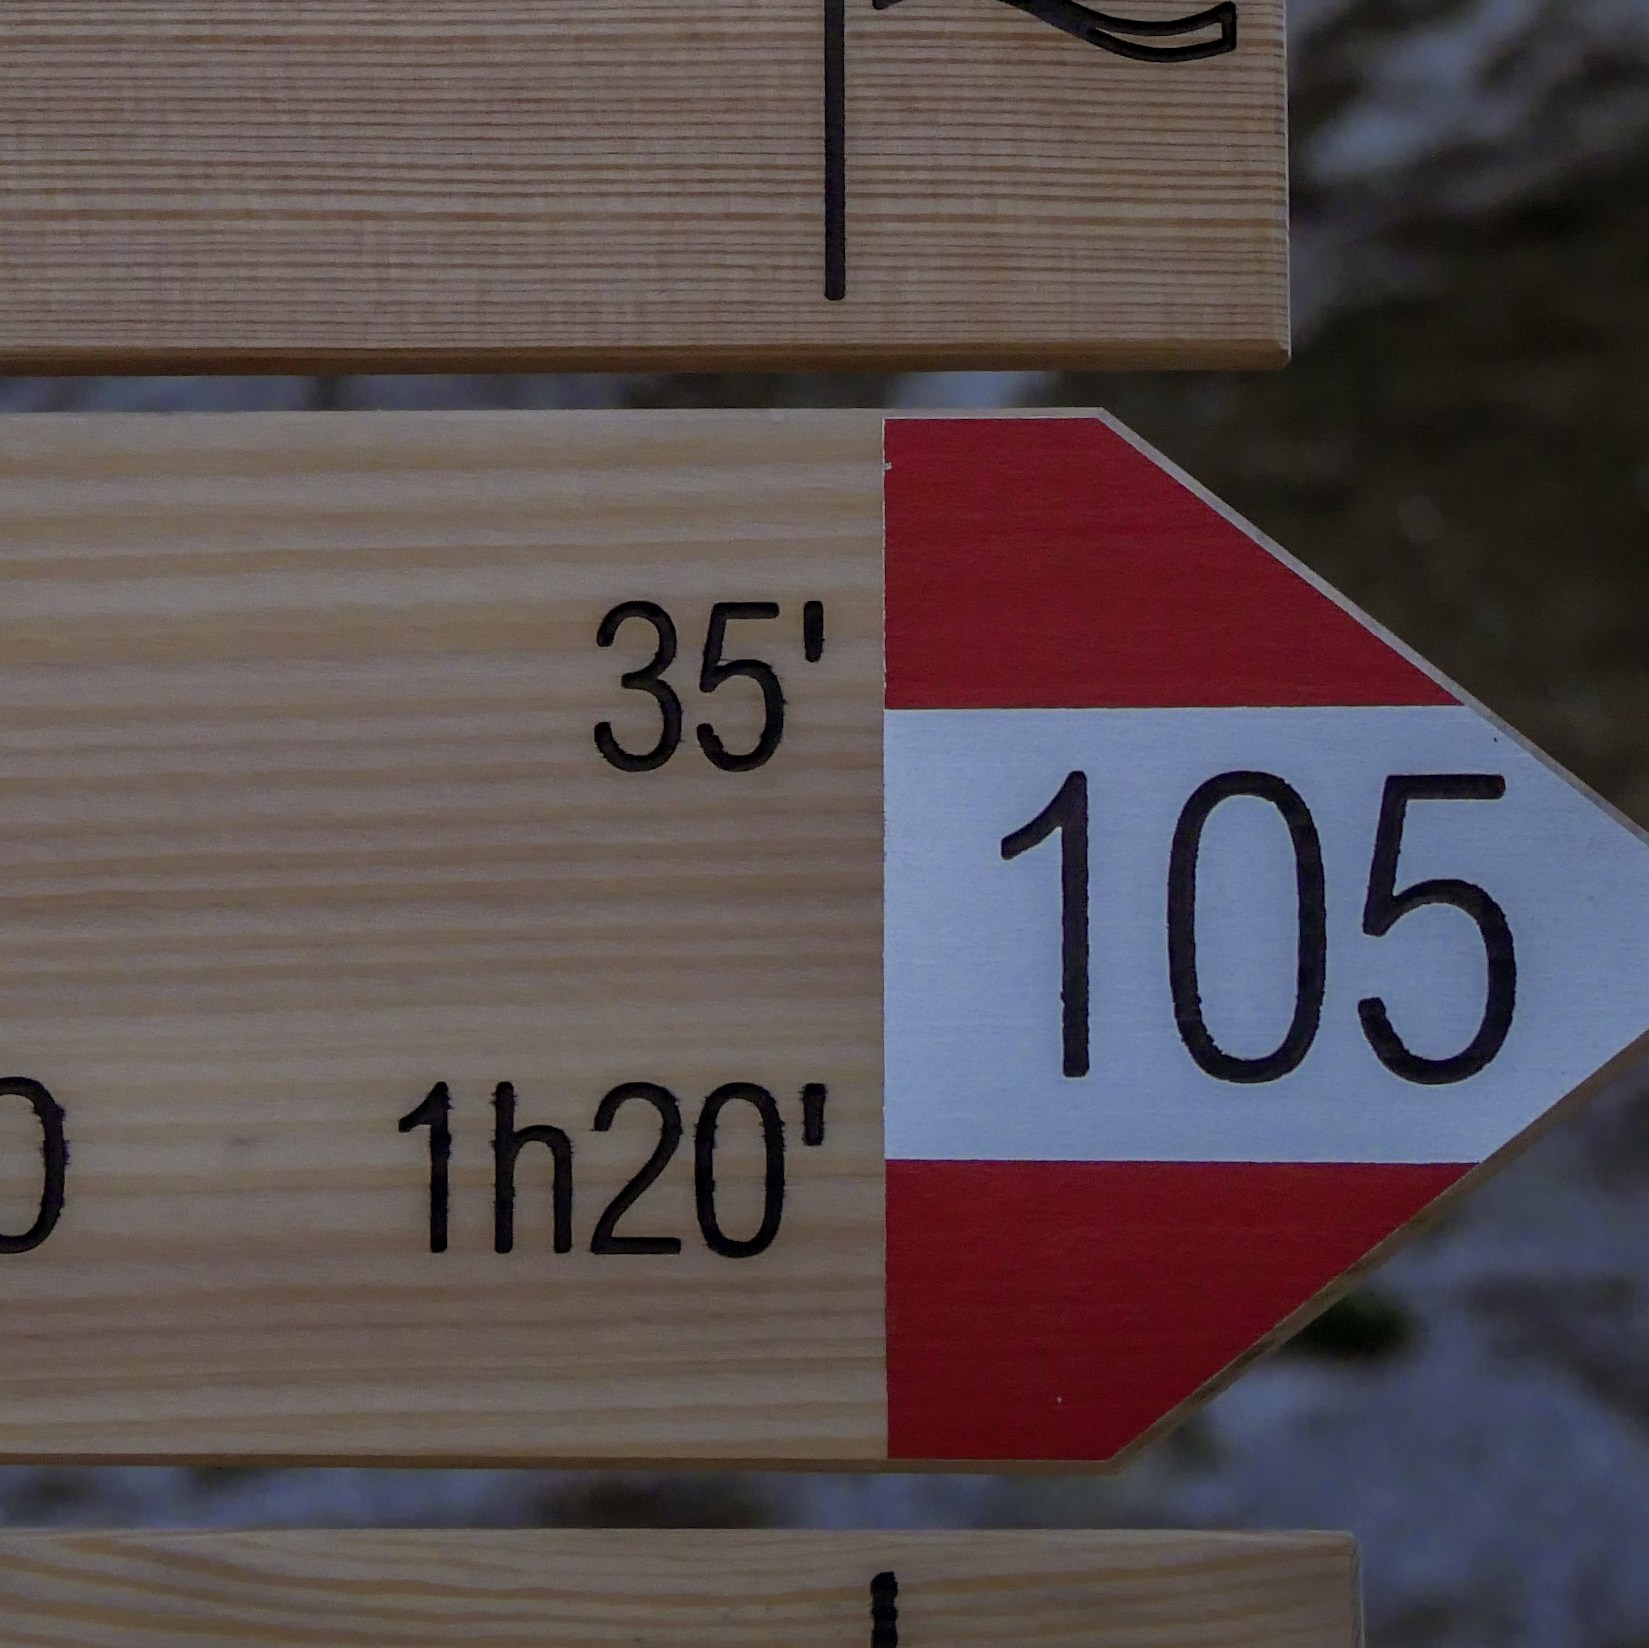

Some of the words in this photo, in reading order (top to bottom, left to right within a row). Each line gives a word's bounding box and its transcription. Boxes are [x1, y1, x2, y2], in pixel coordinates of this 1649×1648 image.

[593, 600, 826, 773] 35'
[1000, 770, 1518, 1086] 105
[398, 1080, 828, 1260] 1h20'
